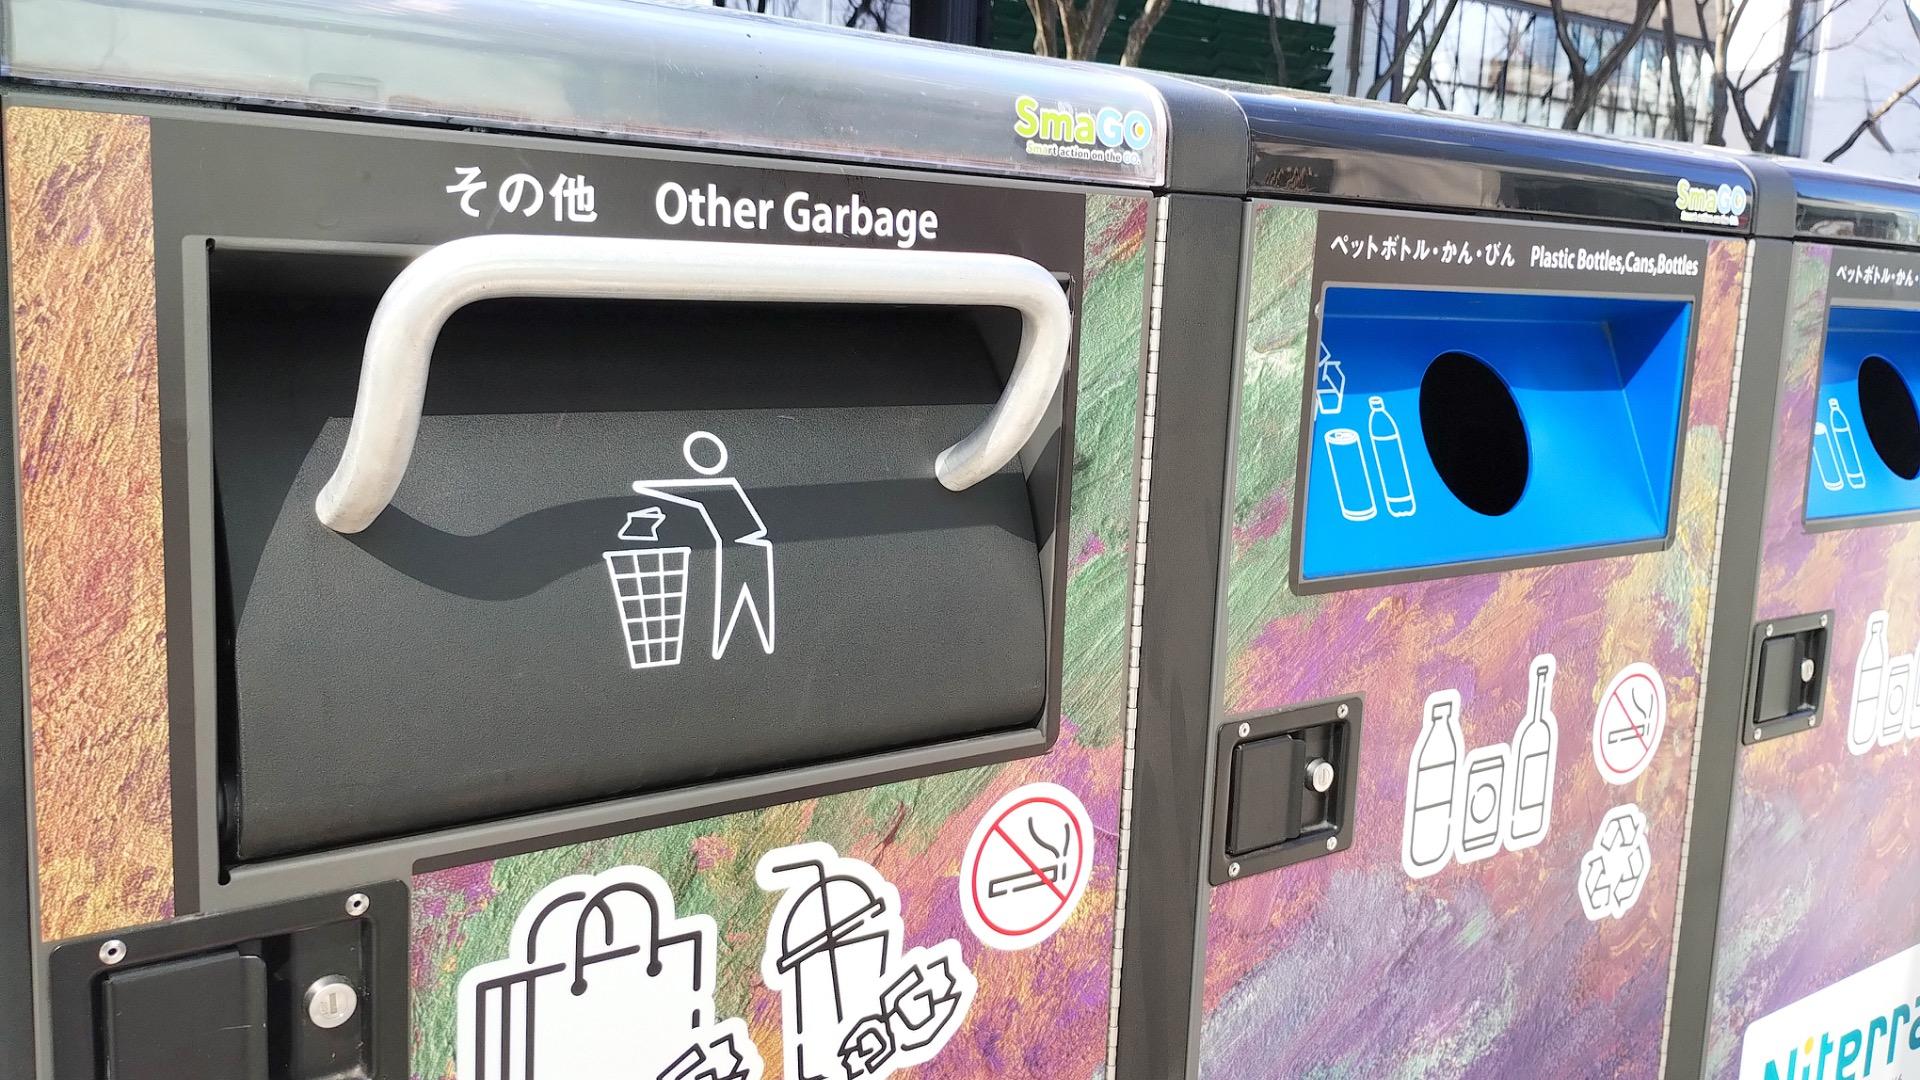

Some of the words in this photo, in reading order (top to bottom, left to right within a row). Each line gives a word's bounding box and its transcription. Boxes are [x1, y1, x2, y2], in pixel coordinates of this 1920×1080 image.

[1014, 96, 1152, 150] SmaGO
[1027, 141, 1058, 156] Smart
[1060, 143, 1089, 159] action
[1091, 150, 1104, 161] on
[1106, 149, 1121, 163] the
[446, 166, 598, 223] その他
[655, 181, 774, 230] Other
[783, 191, 939, 249] Garbage
[1675, 178, 1747, 216] SmaGO
[1530, 245, 1575, 269] Plastic
[1763, 995, 1920, 1080] iterr
